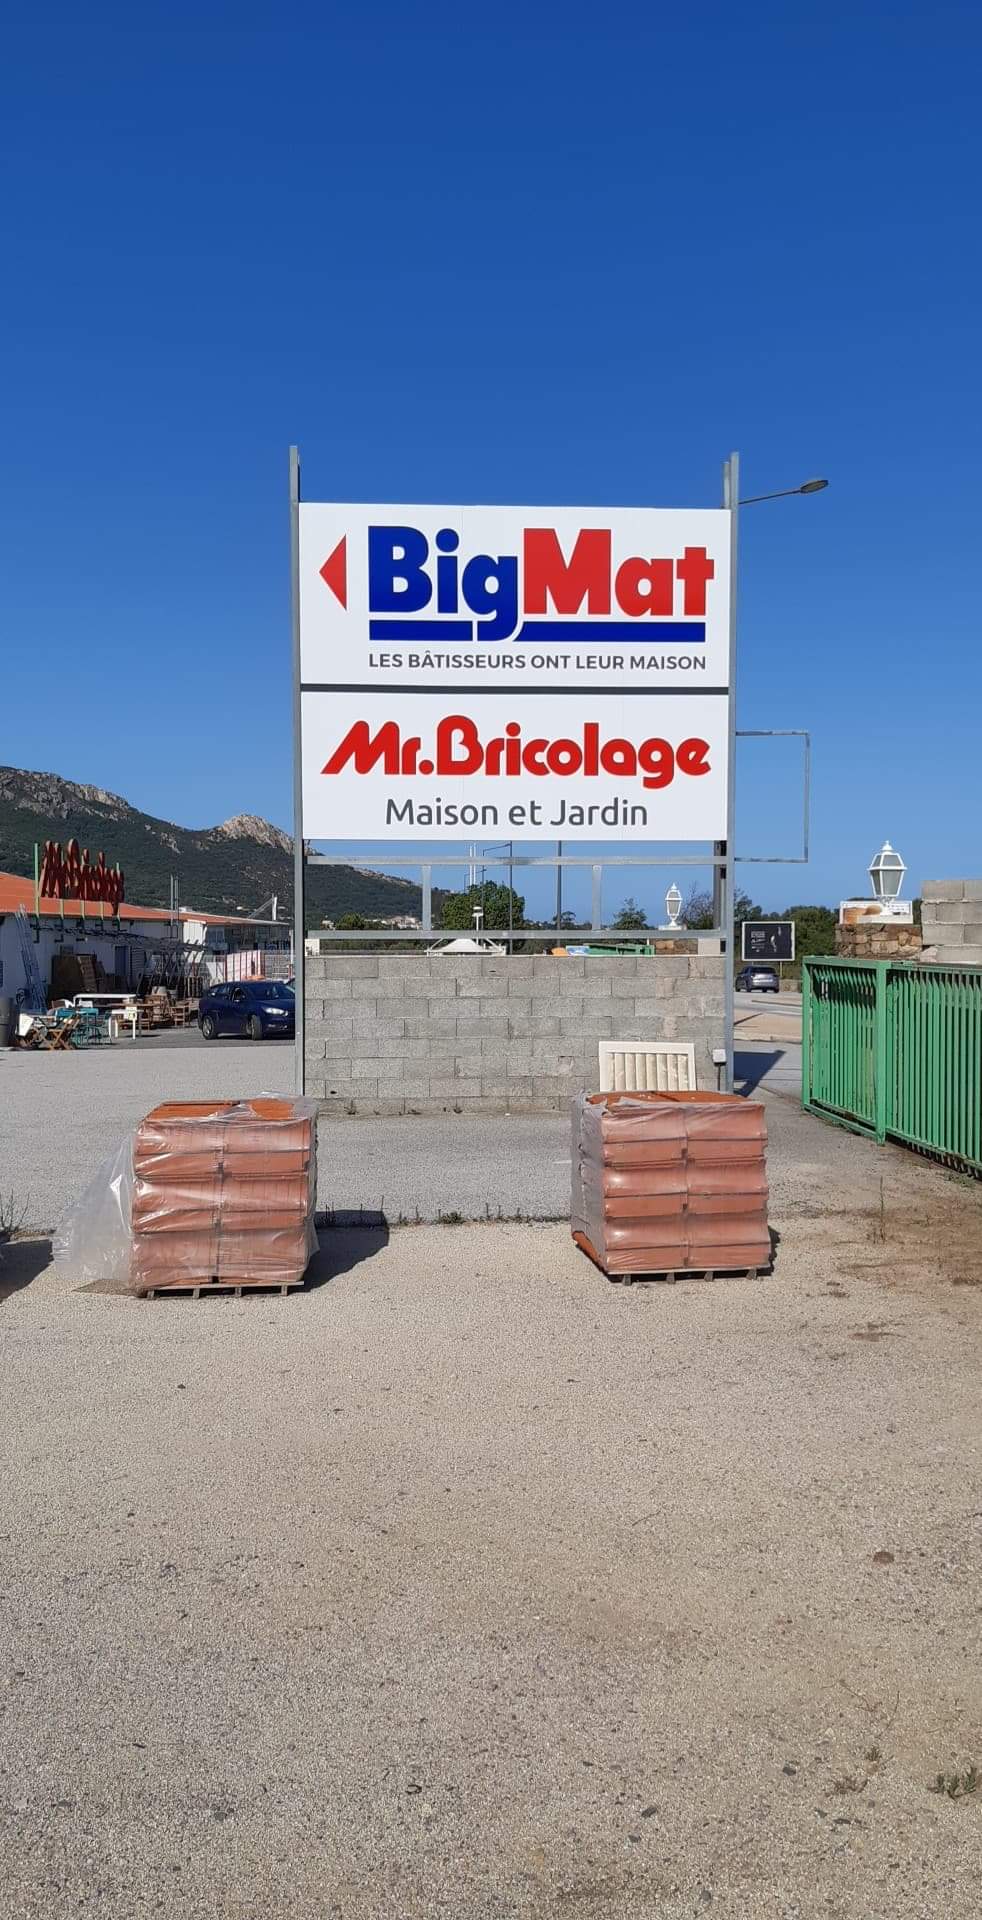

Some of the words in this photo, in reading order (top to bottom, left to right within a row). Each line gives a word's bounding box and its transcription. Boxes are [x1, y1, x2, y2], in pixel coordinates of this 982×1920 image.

[368, 526, 714, 642] BigMat
[369, 653, 403, 668] LES
[408, 650, 526, 669] BÂTISSEURS
[530, 655, 571, 669] ONT
[576, 656, 624, 670] LEUR
[630, 656, 706, 670] MAISON
[386, 797, 498, 825] Maison
[508, 801, 543, 825] et
[550, 799, 648, 826] Jardin
